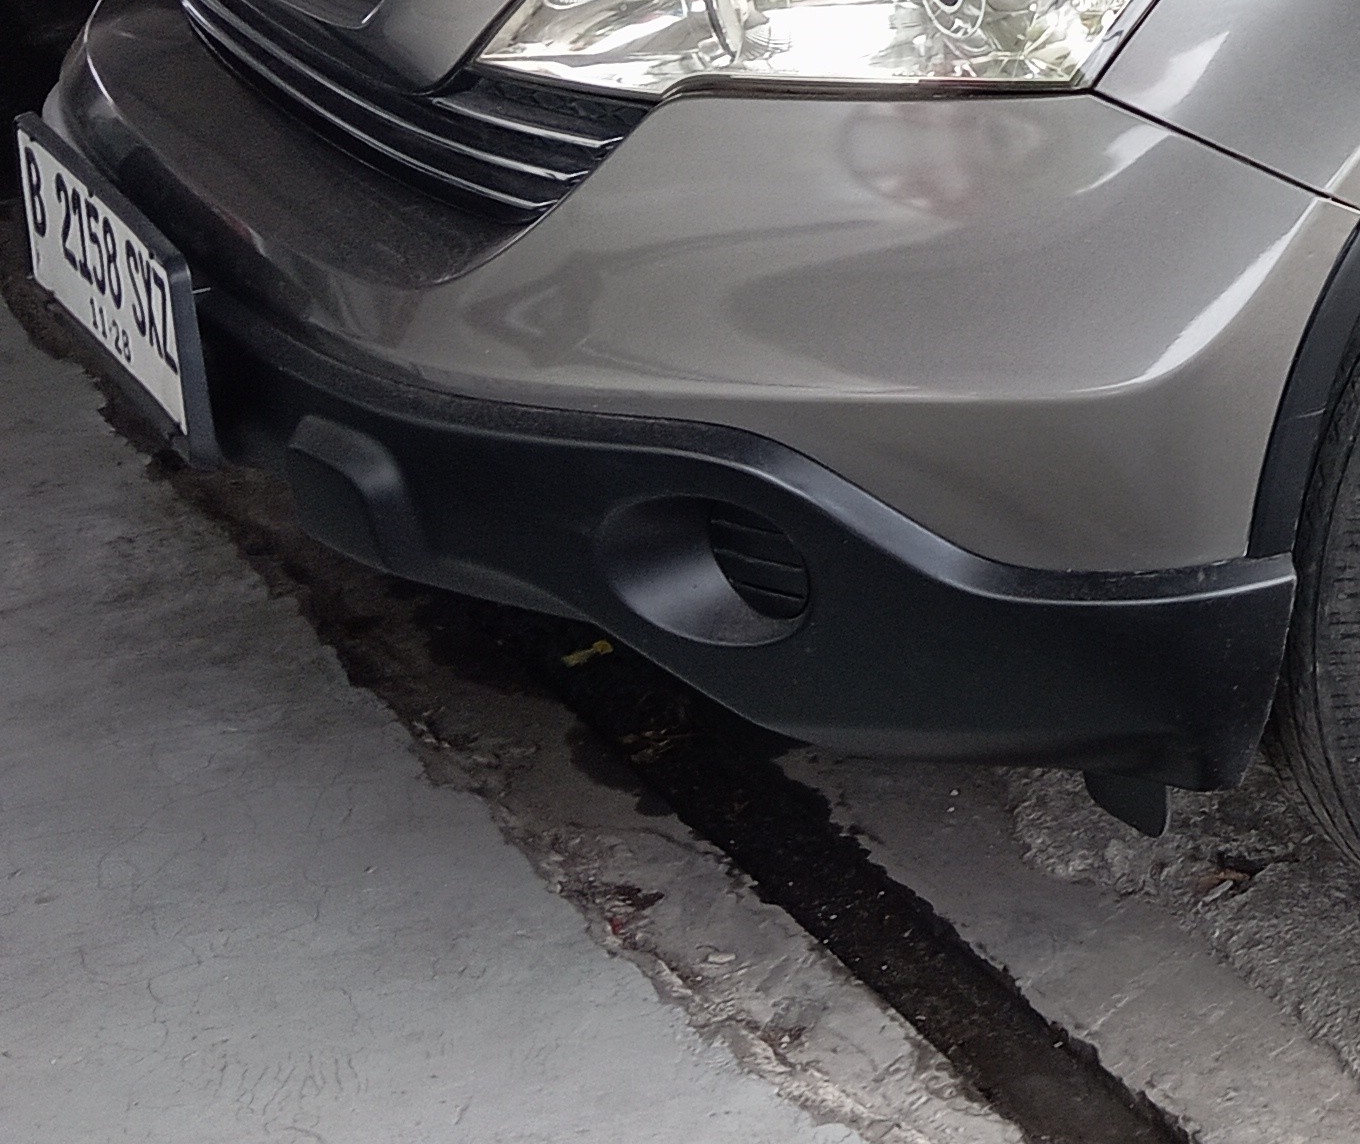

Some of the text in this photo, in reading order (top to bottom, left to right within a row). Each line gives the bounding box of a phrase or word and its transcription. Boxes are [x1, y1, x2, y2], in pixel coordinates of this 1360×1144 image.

[24, 145, 180, 376] B 2158 SXZ
